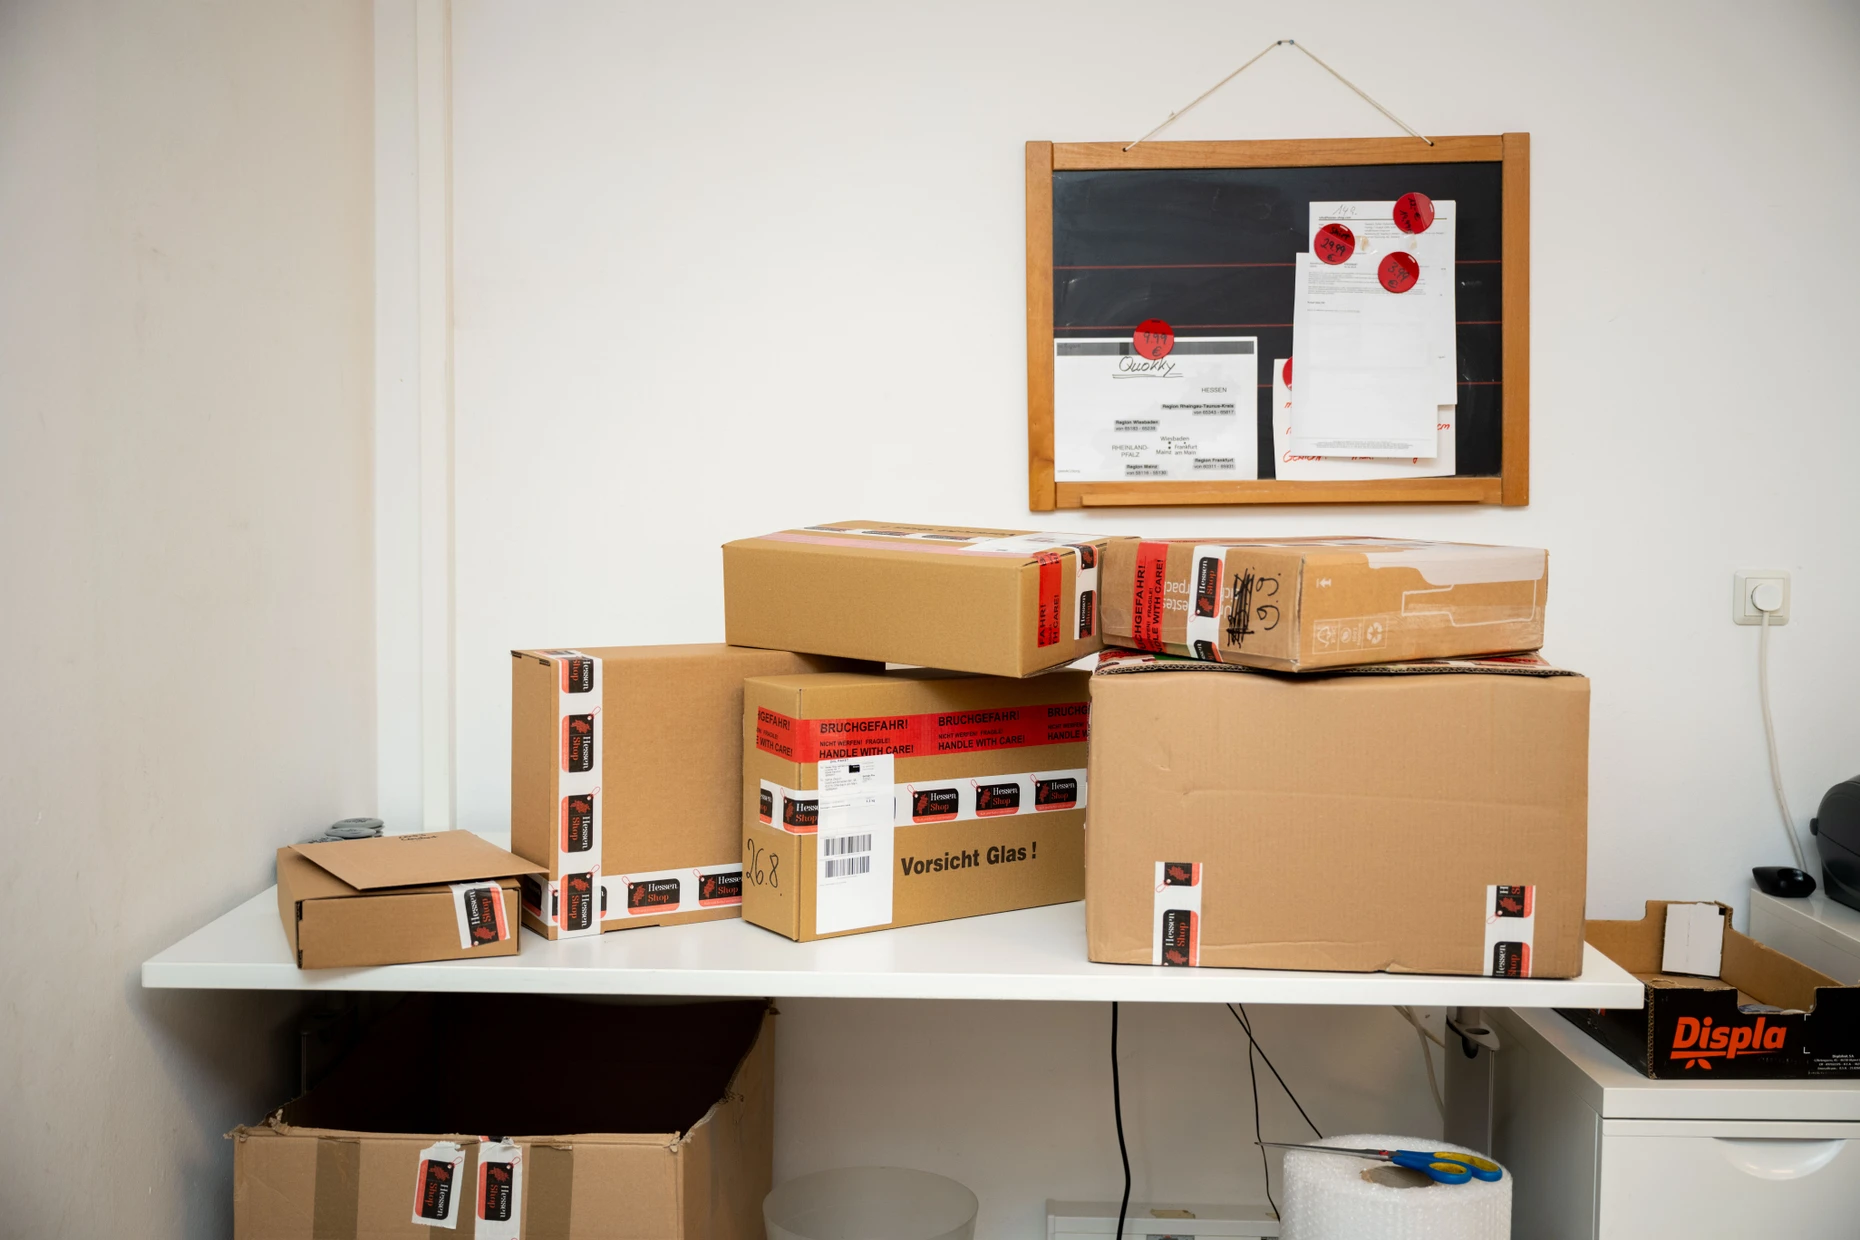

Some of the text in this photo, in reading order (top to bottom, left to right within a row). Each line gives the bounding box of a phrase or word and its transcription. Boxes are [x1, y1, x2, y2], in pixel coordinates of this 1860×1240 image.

[1118, 356, 1176, 377] Quokky
[1154, 558, 1165, 593] CARE!
[1198, 560, 1208, 594] Hessen
[1207, 570, 1217, 595] Shop
[1134, 564, 1147, 650] UCHGEFAHR!
[938, 710, 1020, 727] BRUCHGEFAHR!
[1047, 704, 1088, 718] BRUCHG
[820, 719, 908, 734] BRUCHGEFAHR!
[1047, 730, 1080, 740] HANDLE
[570, 736, 580, 761] Shop
[582, 736, 591, 770] Hessen
[760, 737, 793, 757] WITH CARE!
[819, 744, 914, 759] HANDLE WITH CARE!
[837, 739, 863, 747] WERFEN!
[865, 737, 890, 745] FRAGILE!
[938, 735, 1025, 750] HANDLE WITH CARE!
[930, 792, 957, 801] Hessen
[992, 787, 1018, 796] Hessen
[1051, 781, 1075, 790] Hessen
[1051, 791, 1069, 801] Shop
[929, 802, 949, 813] Shop
[992, 796, 1011, 807] Shop
[569, 816, 580, 841] Shop
[582, 815, 591, 850] Hessen
[901, 850, 980, 876] Vorsicht
[986, 845, 1027, 866] Glas
[648, 882, 679, 892] Hessen
[718, 875, 742, 884] Hesse
[718, 886, 739, 895] Shop
[467, 888, 481, 926] Hessen
[481, 897, 492, 923] Shop
[569, 895, 579, 919] Shop
[647, 893, 669, 904] Shop
[581, 894, 590, 928] Hessen
[1165, 912, 1175, 946] Hessen
[1177, 922, 1189, 947] Shop
[1671, 1016, 1787, 1059] Displa
[425, 1182, 438, 1207] Shop
[436, 1183, 449, 1217] Hessen
[487, 1184, 498, 1209] Shop
[500, 1185, 509, 1218] Hessen
